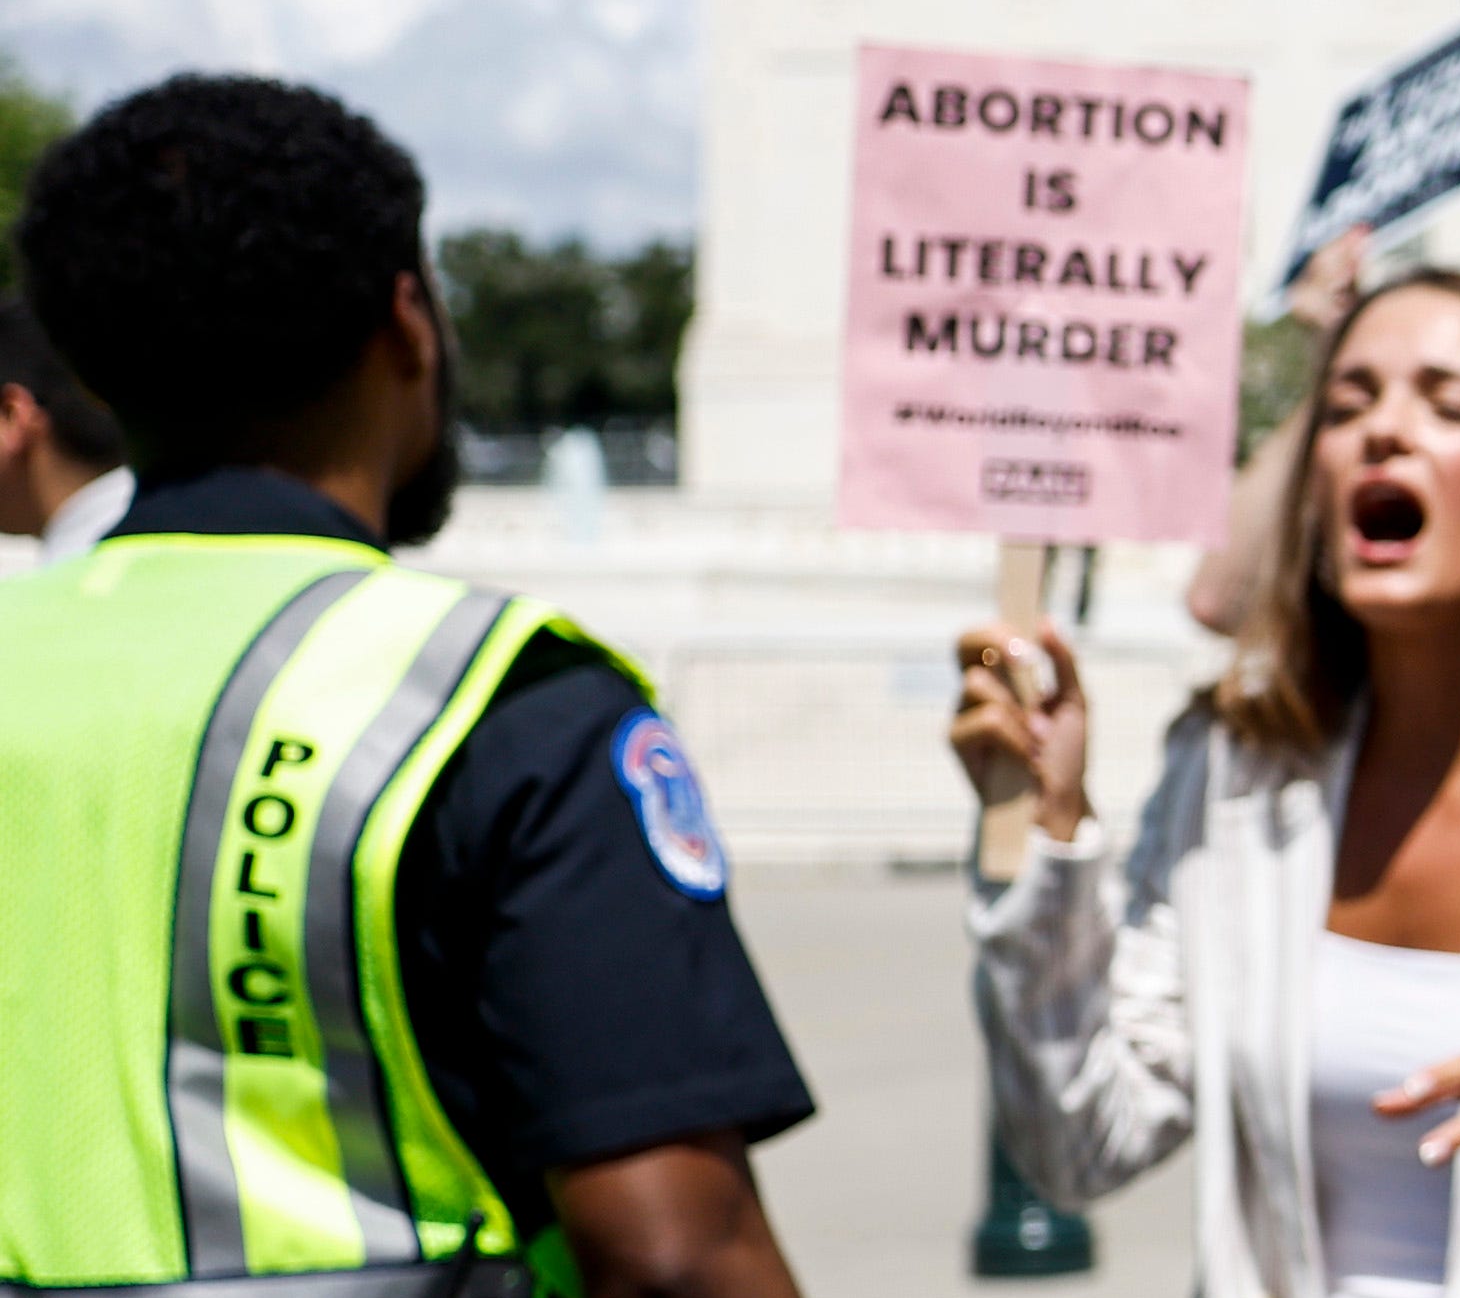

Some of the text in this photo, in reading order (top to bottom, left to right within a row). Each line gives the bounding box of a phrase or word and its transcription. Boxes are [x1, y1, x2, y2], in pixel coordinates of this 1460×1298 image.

[878, 82, 1229, 149] ABORTION
[1021, 167, 1078, 215] IS
[878, 233, 1209, 295] LITERALLY
[903, 312, 1180, 370] MURDER
[228, 739, 314, 1058] POLICE
